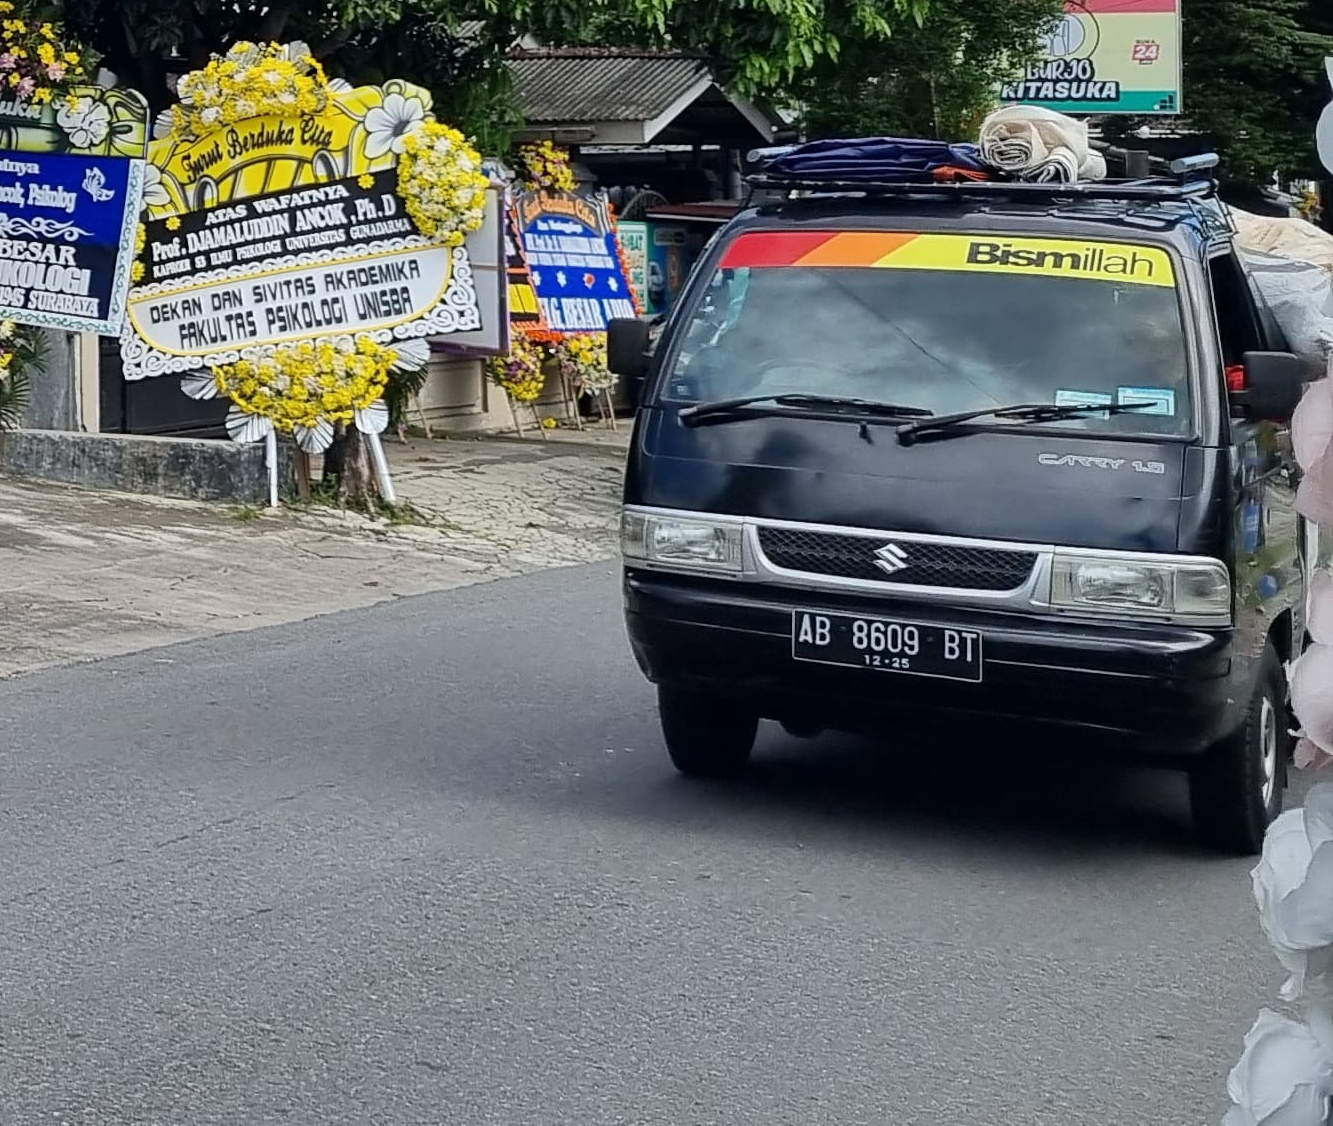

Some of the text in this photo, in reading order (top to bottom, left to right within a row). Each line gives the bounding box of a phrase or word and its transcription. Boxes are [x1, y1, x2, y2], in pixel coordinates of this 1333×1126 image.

[1134, 45, 1159, 59] 24
[1001, 81, 1117, 100] KITASUKA
[182, 116, 332, 183] Turut Berduka Cita
[205, 184, 350, 226] ATAS WAFATNYA
[151, 237, 186, 262] Prof.
[285, 229, 345, 250] UNIVERSITAS
[966, 241, 1154, 277] Bismillah
[27, 289, 101, 317] SURABAYA
[149, 258, 421, 324] DEKAN DAN SIVITAS AKADEMIKA
[179, 285, 414, 349] FAKULTAS PSIKOLOGI UNISBA
[1039, 452, 1126, 471] CARRY
[799, 614, 978, 662] AB 8609 BT
